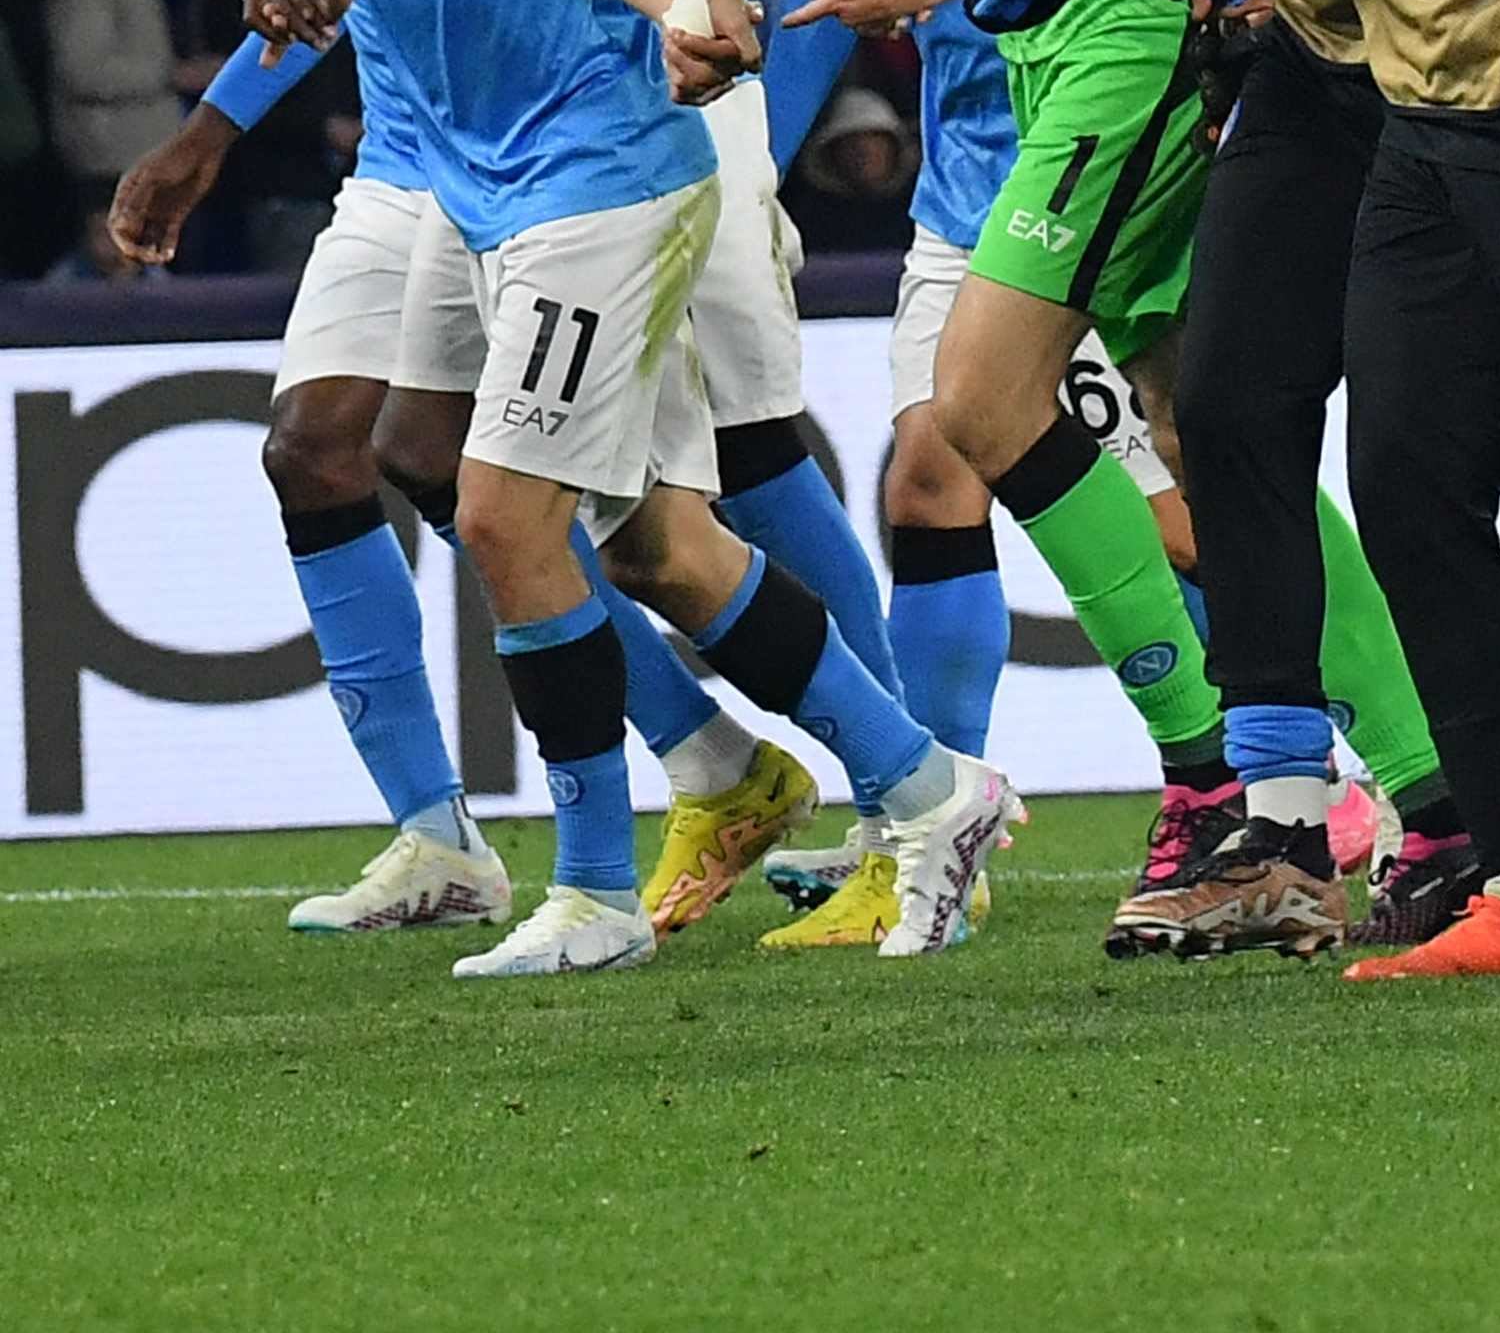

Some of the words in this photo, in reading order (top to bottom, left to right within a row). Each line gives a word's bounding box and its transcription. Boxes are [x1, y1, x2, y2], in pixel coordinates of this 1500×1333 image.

[1046, 133, 1101, 216] 1
[1005, 208, 1077, 253] EA7
[519, 296, 600, 404] 11
[502, 398, 569, 437] EA7
[1065, 360, 1148, 439] 6
[1102, 430, 1150, 460] EA
